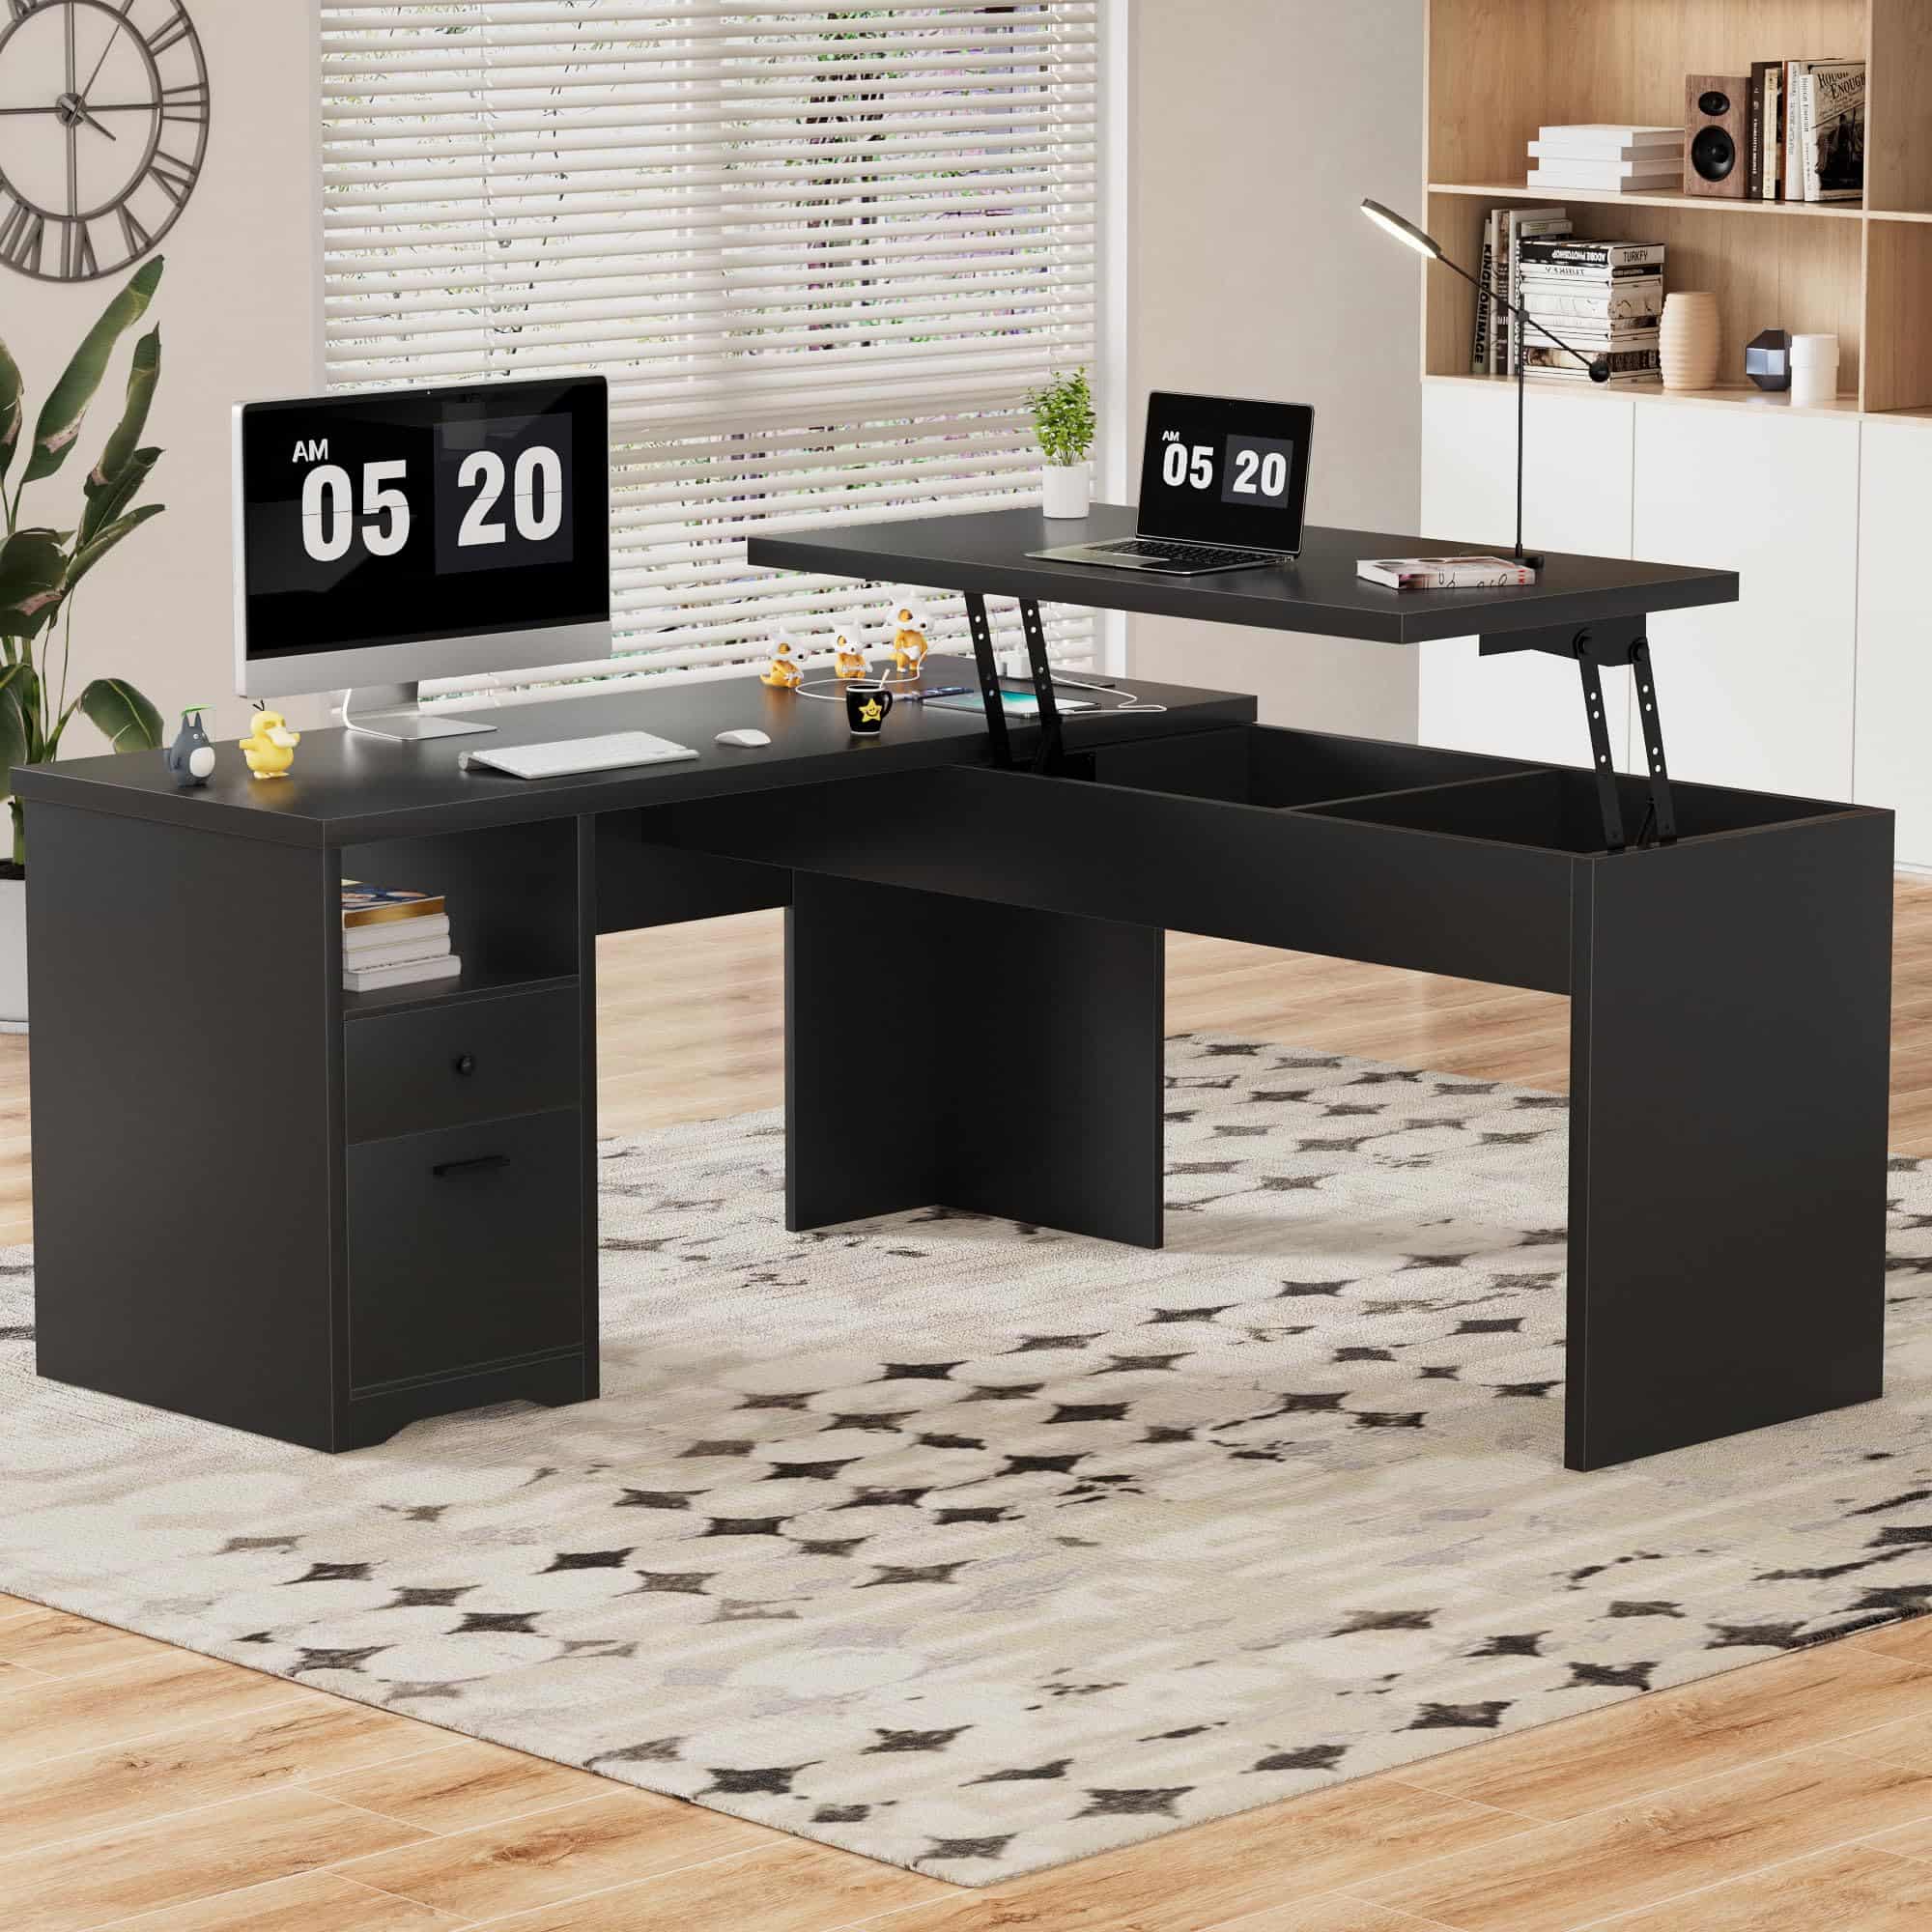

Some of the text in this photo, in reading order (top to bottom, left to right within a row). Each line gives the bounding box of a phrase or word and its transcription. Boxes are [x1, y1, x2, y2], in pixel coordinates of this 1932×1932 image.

[292, 439, 328, 463] AM
[1162, 431, 1180, 441] AM
[1162, 442, 1287, 497] 05 20
[301, 445, 563, 562] 05 20
